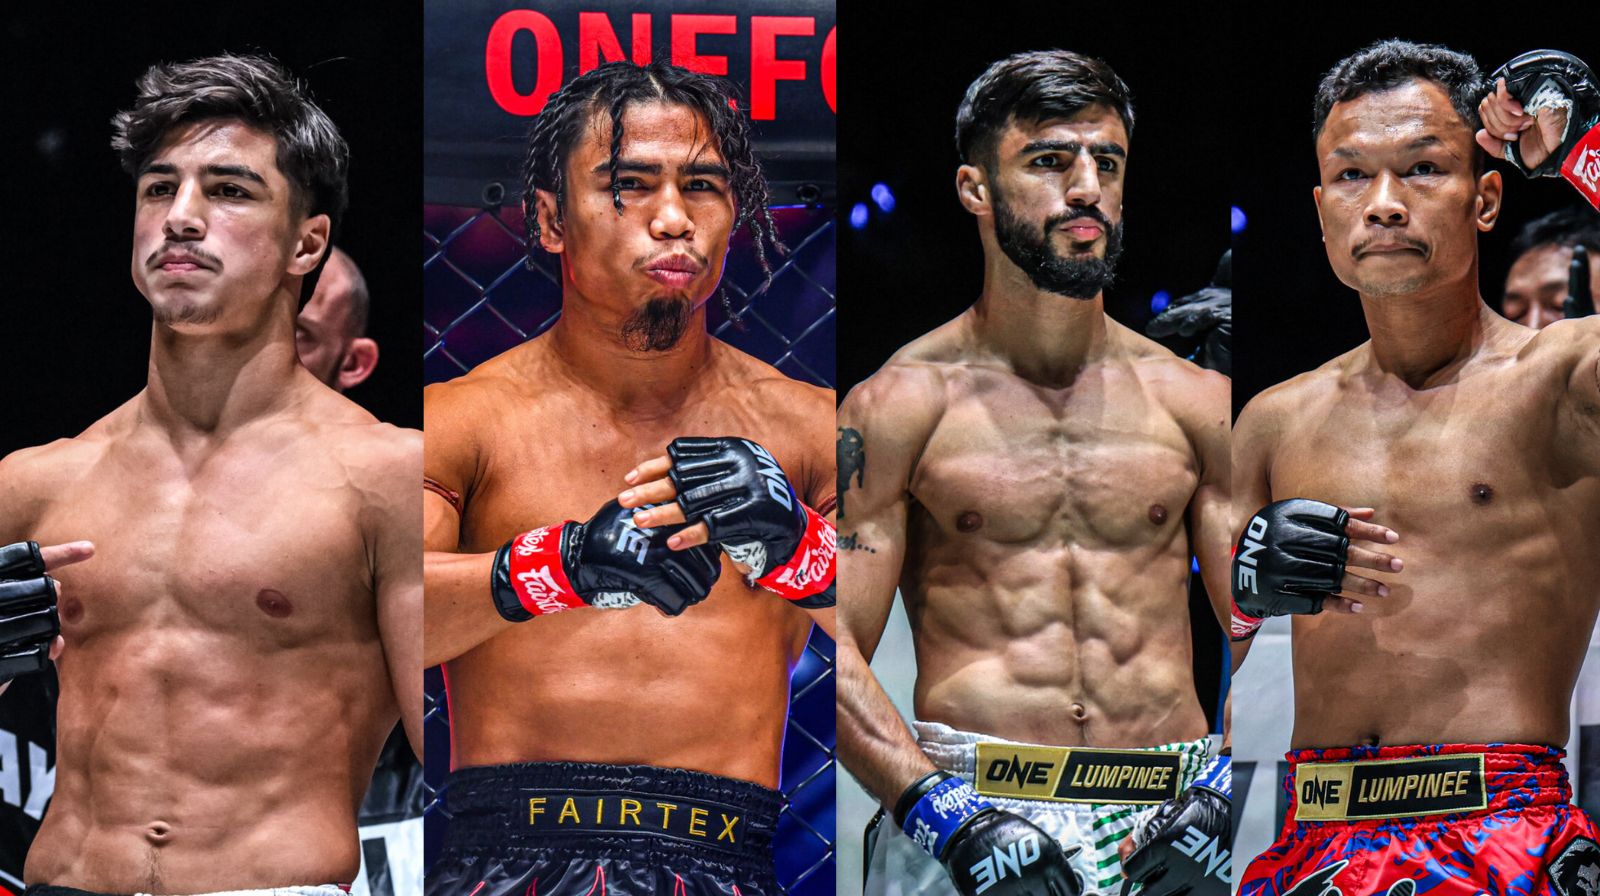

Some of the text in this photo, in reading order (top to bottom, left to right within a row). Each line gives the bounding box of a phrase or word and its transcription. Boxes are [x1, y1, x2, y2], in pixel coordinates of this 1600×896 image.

[485, 9, 836, 121] ONEF
[1237, 515, 1269, 595] ONE
[986, 754, 1054, 789] ONE
[1073, 764, 1173, 790] LUMPINEE
[1301, 770, 1472, 811] ONE LUMPINEE
[528, 797, 740, 843] FAIRTEX
[969, 832, 1041, 896] ONE
